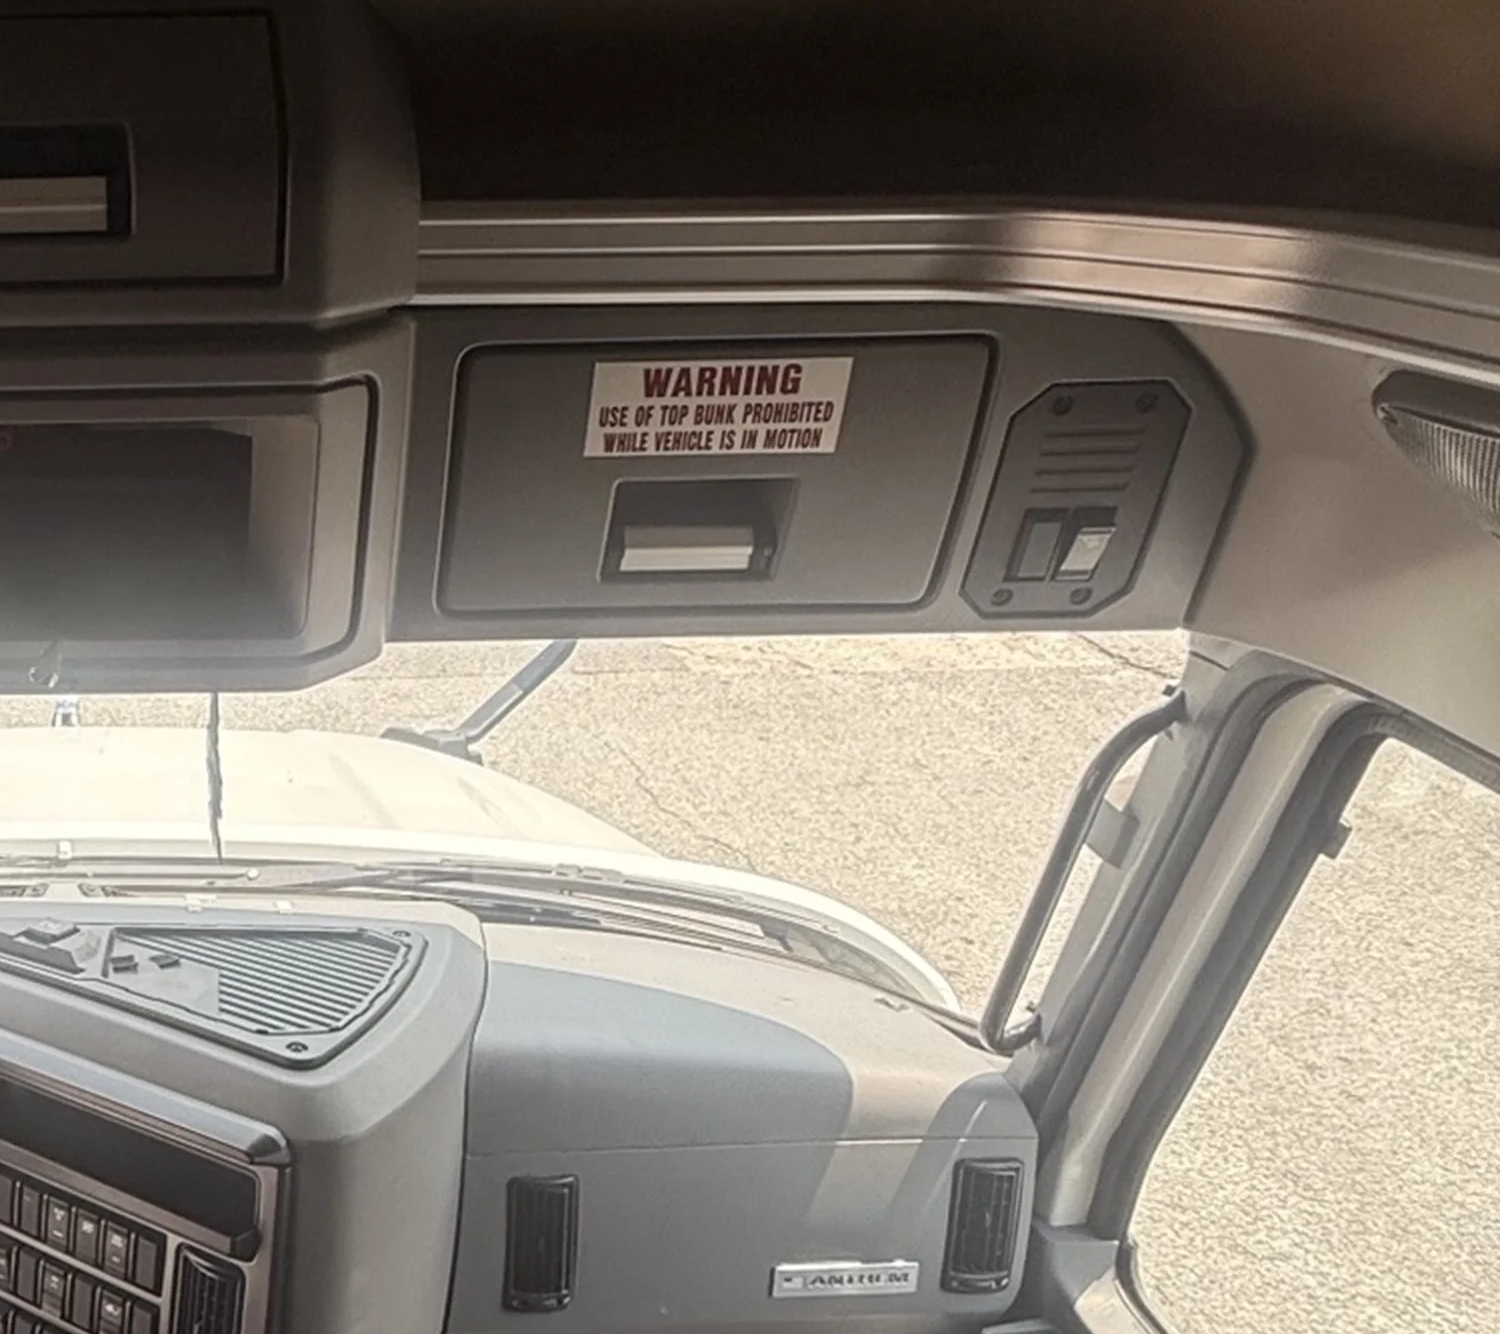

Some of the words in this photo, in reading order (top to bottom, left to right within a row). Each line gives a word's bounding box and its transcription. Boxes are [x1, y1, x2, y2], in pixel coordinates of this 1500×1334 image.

[643, 363, 803, 398] WARNING
[599, 406, 628, 427] USE
[635, 406, 654, 426] OF
[660, 405, 688, 426] TOP
[693, 404, 736, 425] BUNK
[742, 401, 834, 424] PROHIBITED
[603, 432, 648, 453] WHILE
[654, 430, 713, 452] VEHICLE
[720, 430, 735, 450] IS
[740, 430, 757, 449] IN
[763, 428, 823, 449] MOTION
